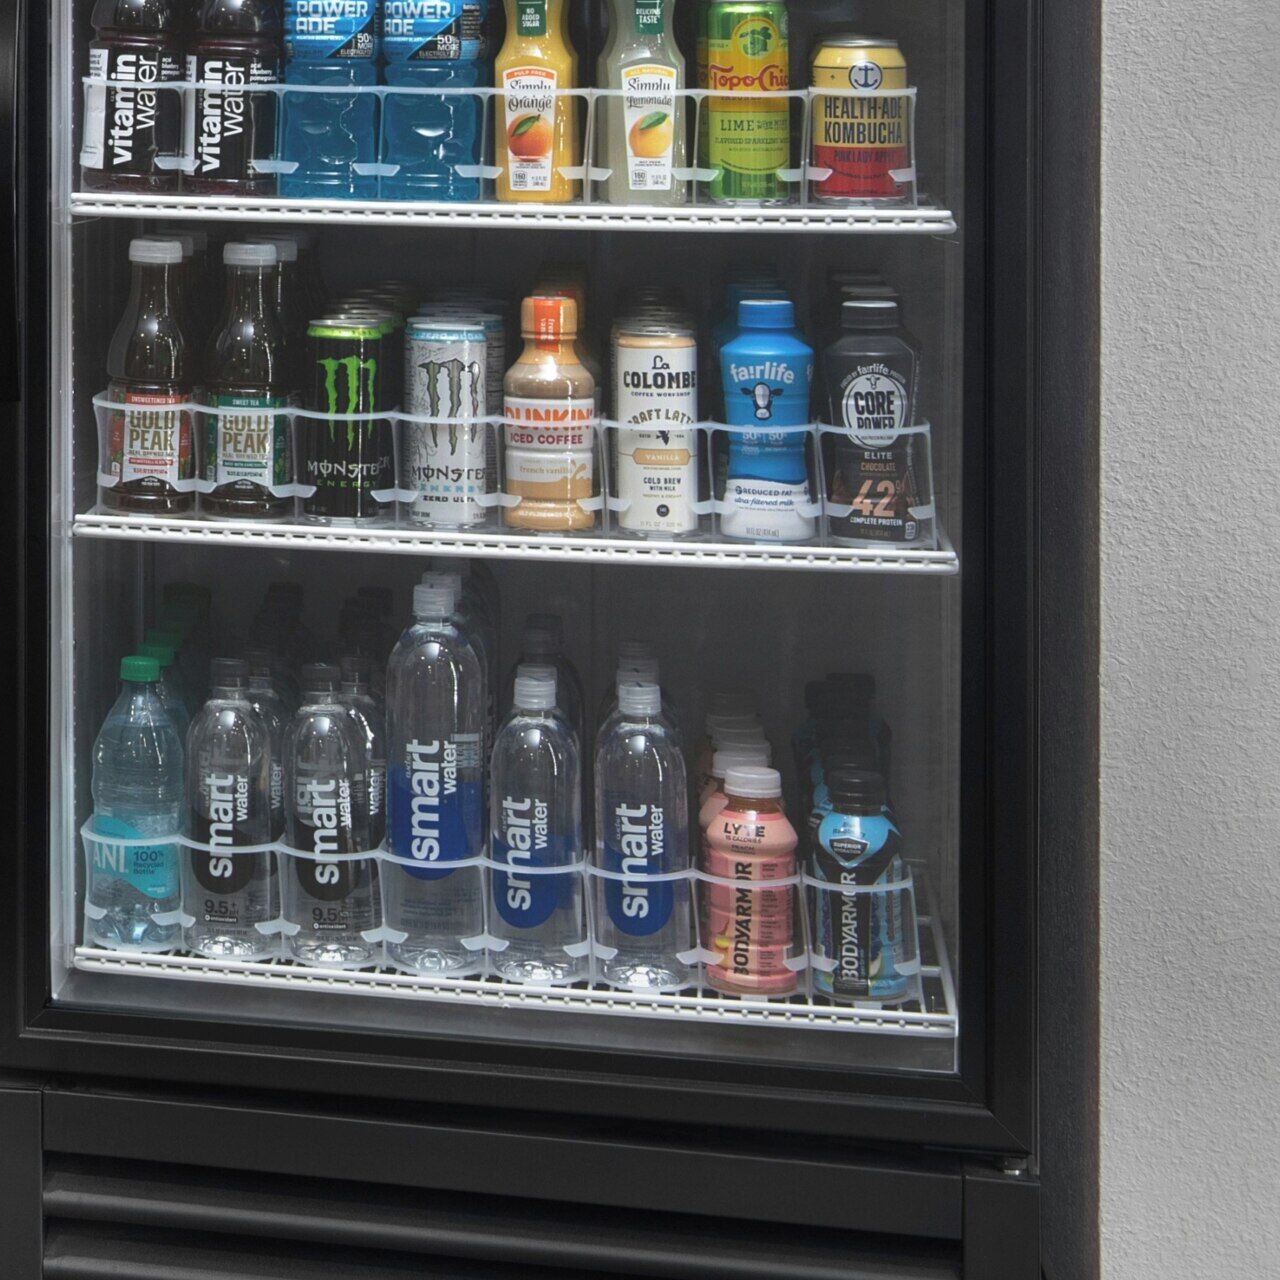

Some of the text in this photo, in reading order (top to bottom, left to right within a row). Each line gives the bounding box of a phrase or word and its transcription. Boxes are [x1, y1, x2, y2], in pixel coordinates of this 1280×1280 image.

[110, 54, 136, 165] vitamin
[824, 122, 902, 144] KOMBUCHA
[624, 371, 696, 389] COLOMBE
[854, 390, 894, 413] CORE
[511, 434, 582, 445] ICED COFFEE
[407, 739, 440, 861] smart
